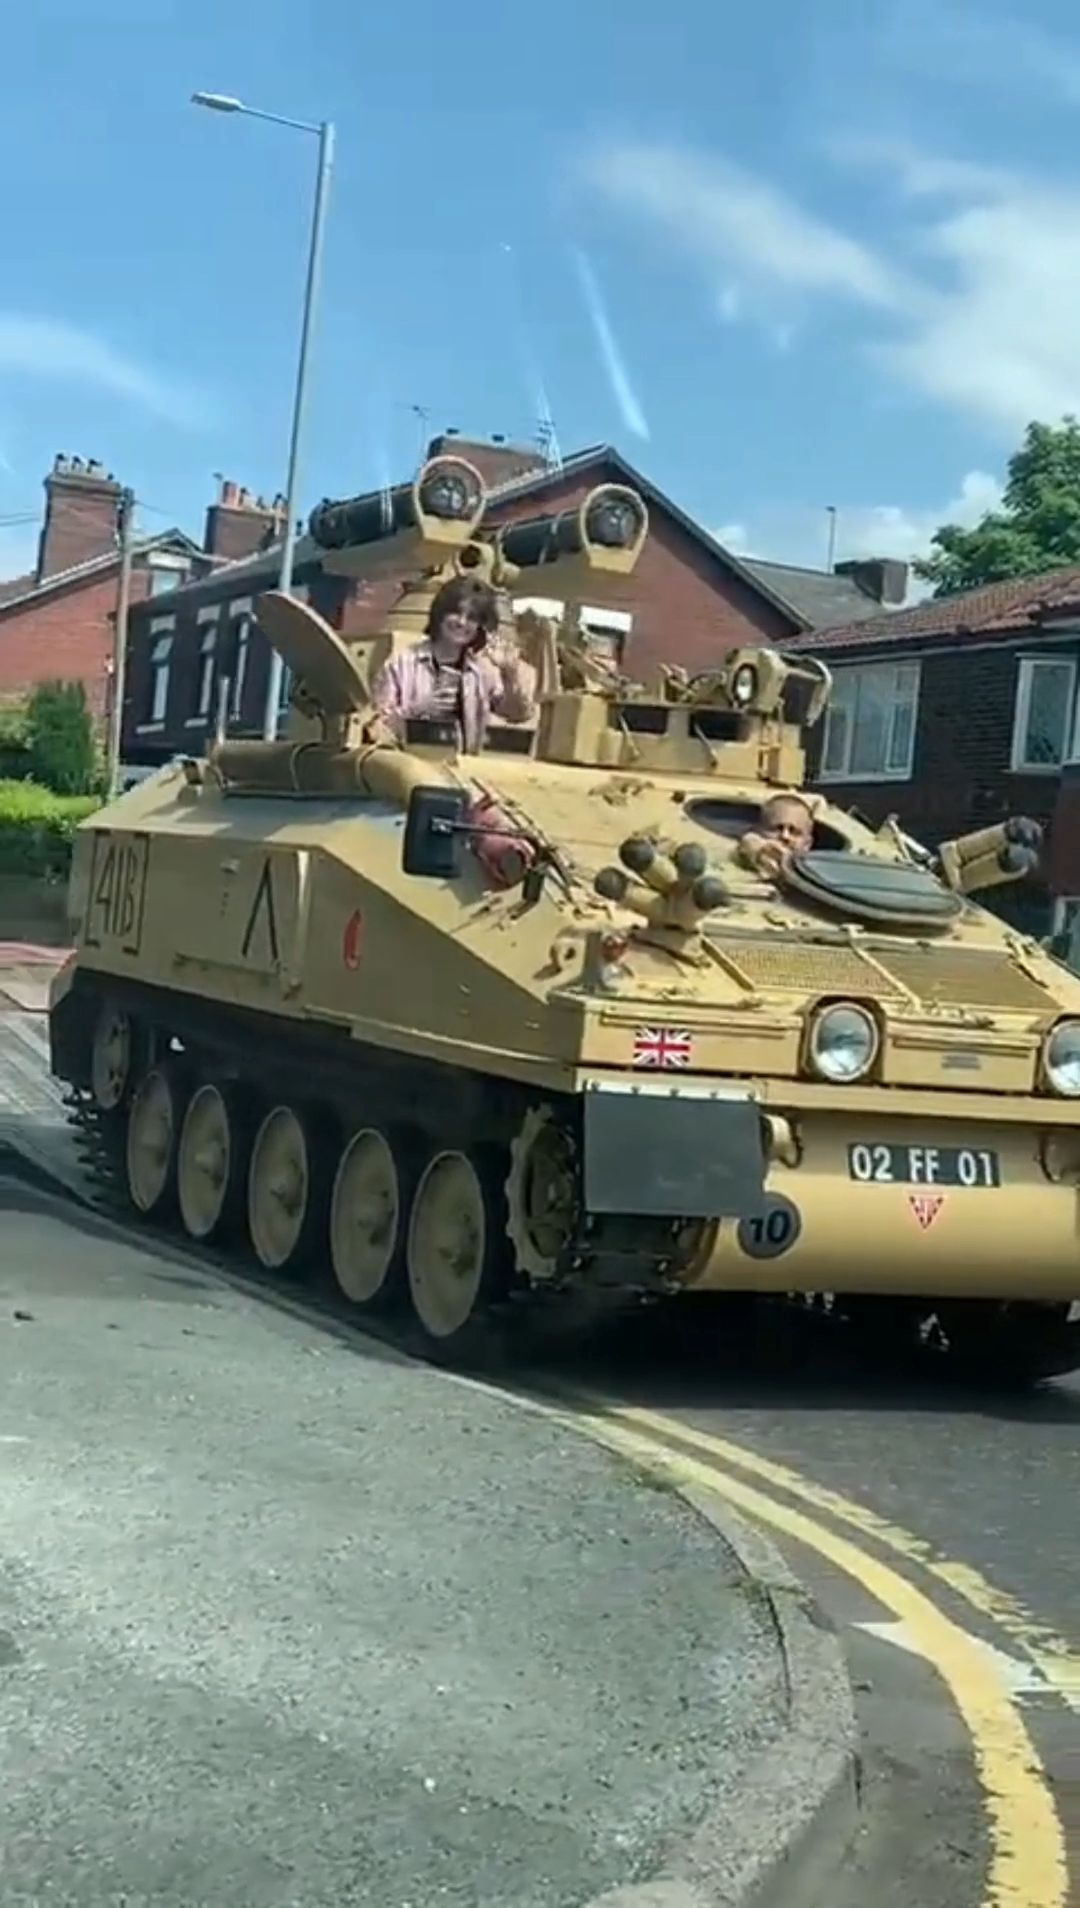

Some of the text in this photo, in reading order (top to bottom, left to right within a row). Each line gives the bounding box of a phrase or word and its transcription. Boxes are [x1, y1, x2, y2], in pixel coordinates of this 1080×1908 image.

[852, 1144, 993, 1187] 02 FF 01
[748, 1209, 791, 1245] 10
